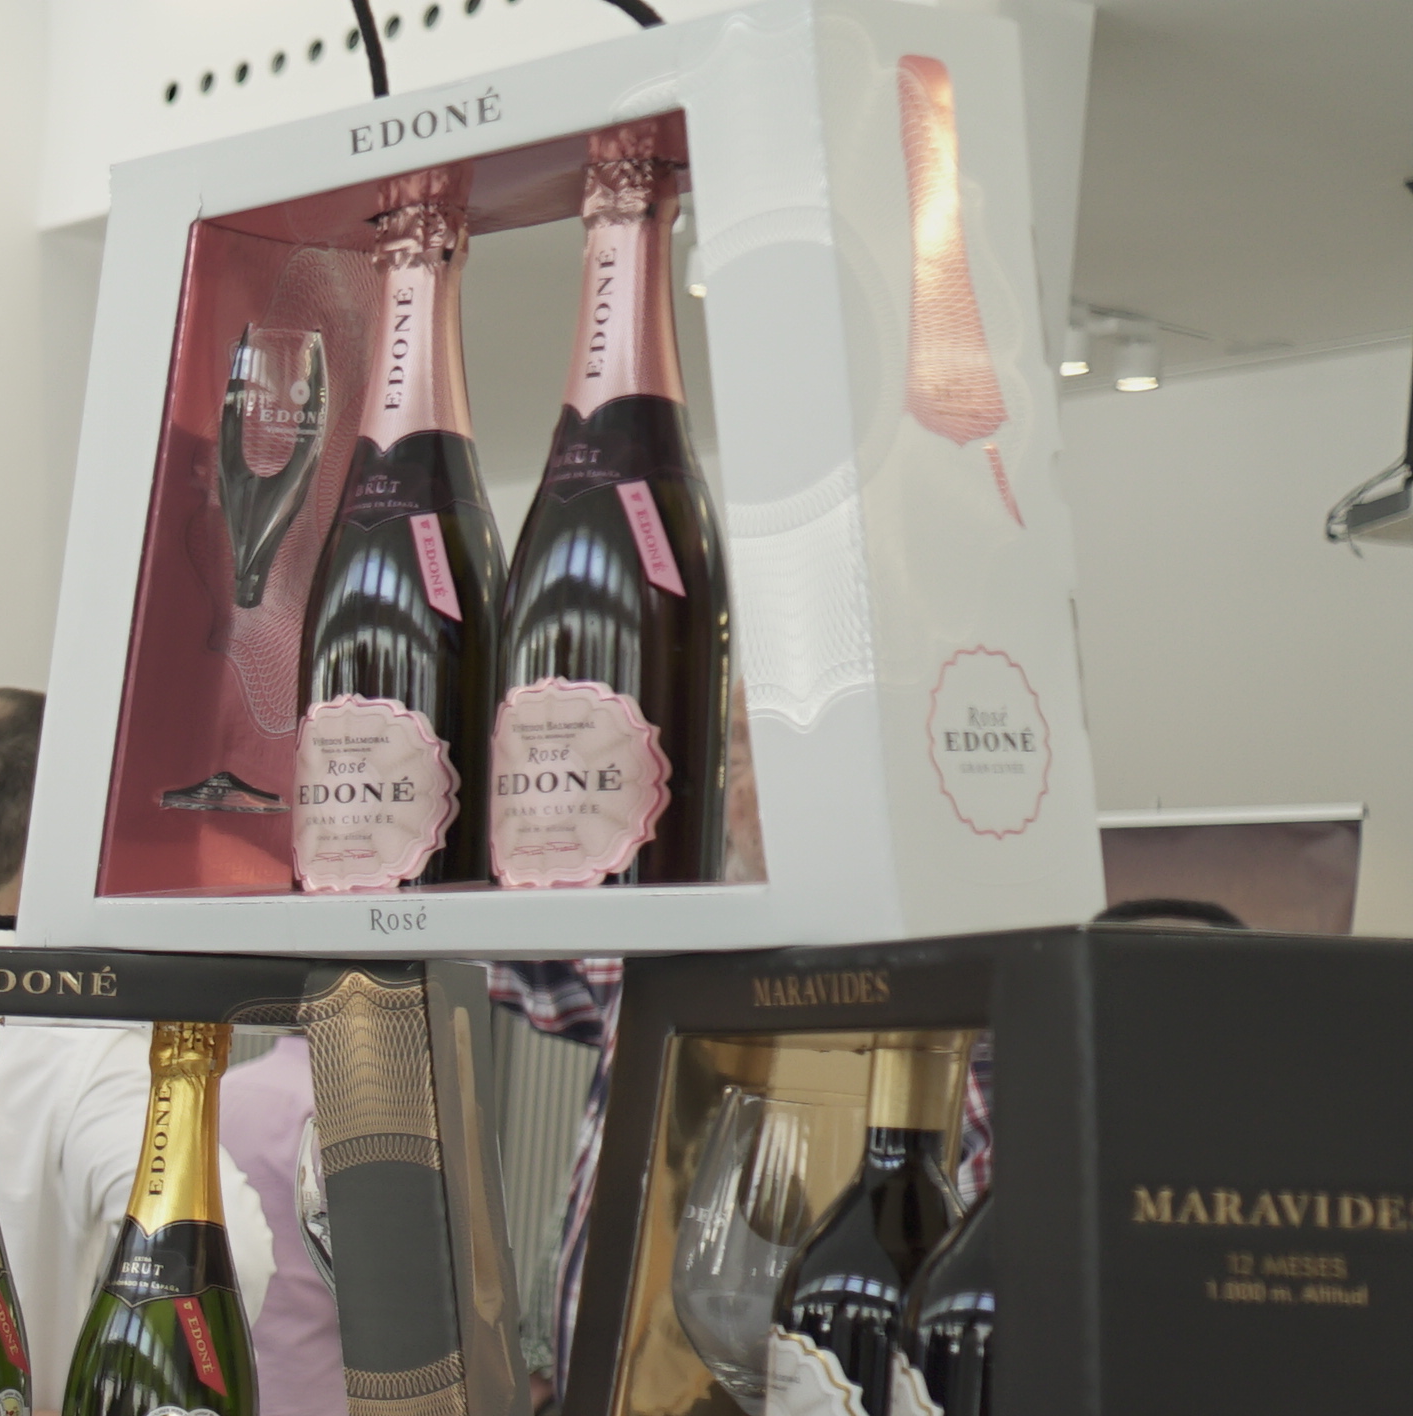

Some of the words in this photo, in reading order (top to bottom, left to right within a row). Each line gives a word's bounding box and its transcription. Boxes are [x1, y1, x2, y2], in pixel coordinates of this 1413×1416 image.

[350, 87, 502, 155] EDONÉ
[586, 247, 616, 379] EDONÉ
[384, 286, 414, 411] EDONÉ
[423, 535, 449, 599] EDONÉ
[528, 744, 570, 764] Rosé
[944, 727, 1036, 752] EDONÉ
[327, 757, 367, 776] Rosé
[497, 763, 623, 796] EDONÉ
[299, 777, 415, 805] EDONÉ
[342, 813, 394, 825] CUVÉE
[370, 906, 427, 935] Rosé
[751, 969, 891, 1007] MARAVIDES
[149, 1081, 172, 1196] EDONÉ
[1132, 1184, 1413, 1231] MARAVIDE
[122, 1261, 165, 1277] BRUT
[188, 1316, 215, 1375] EDONÉ
